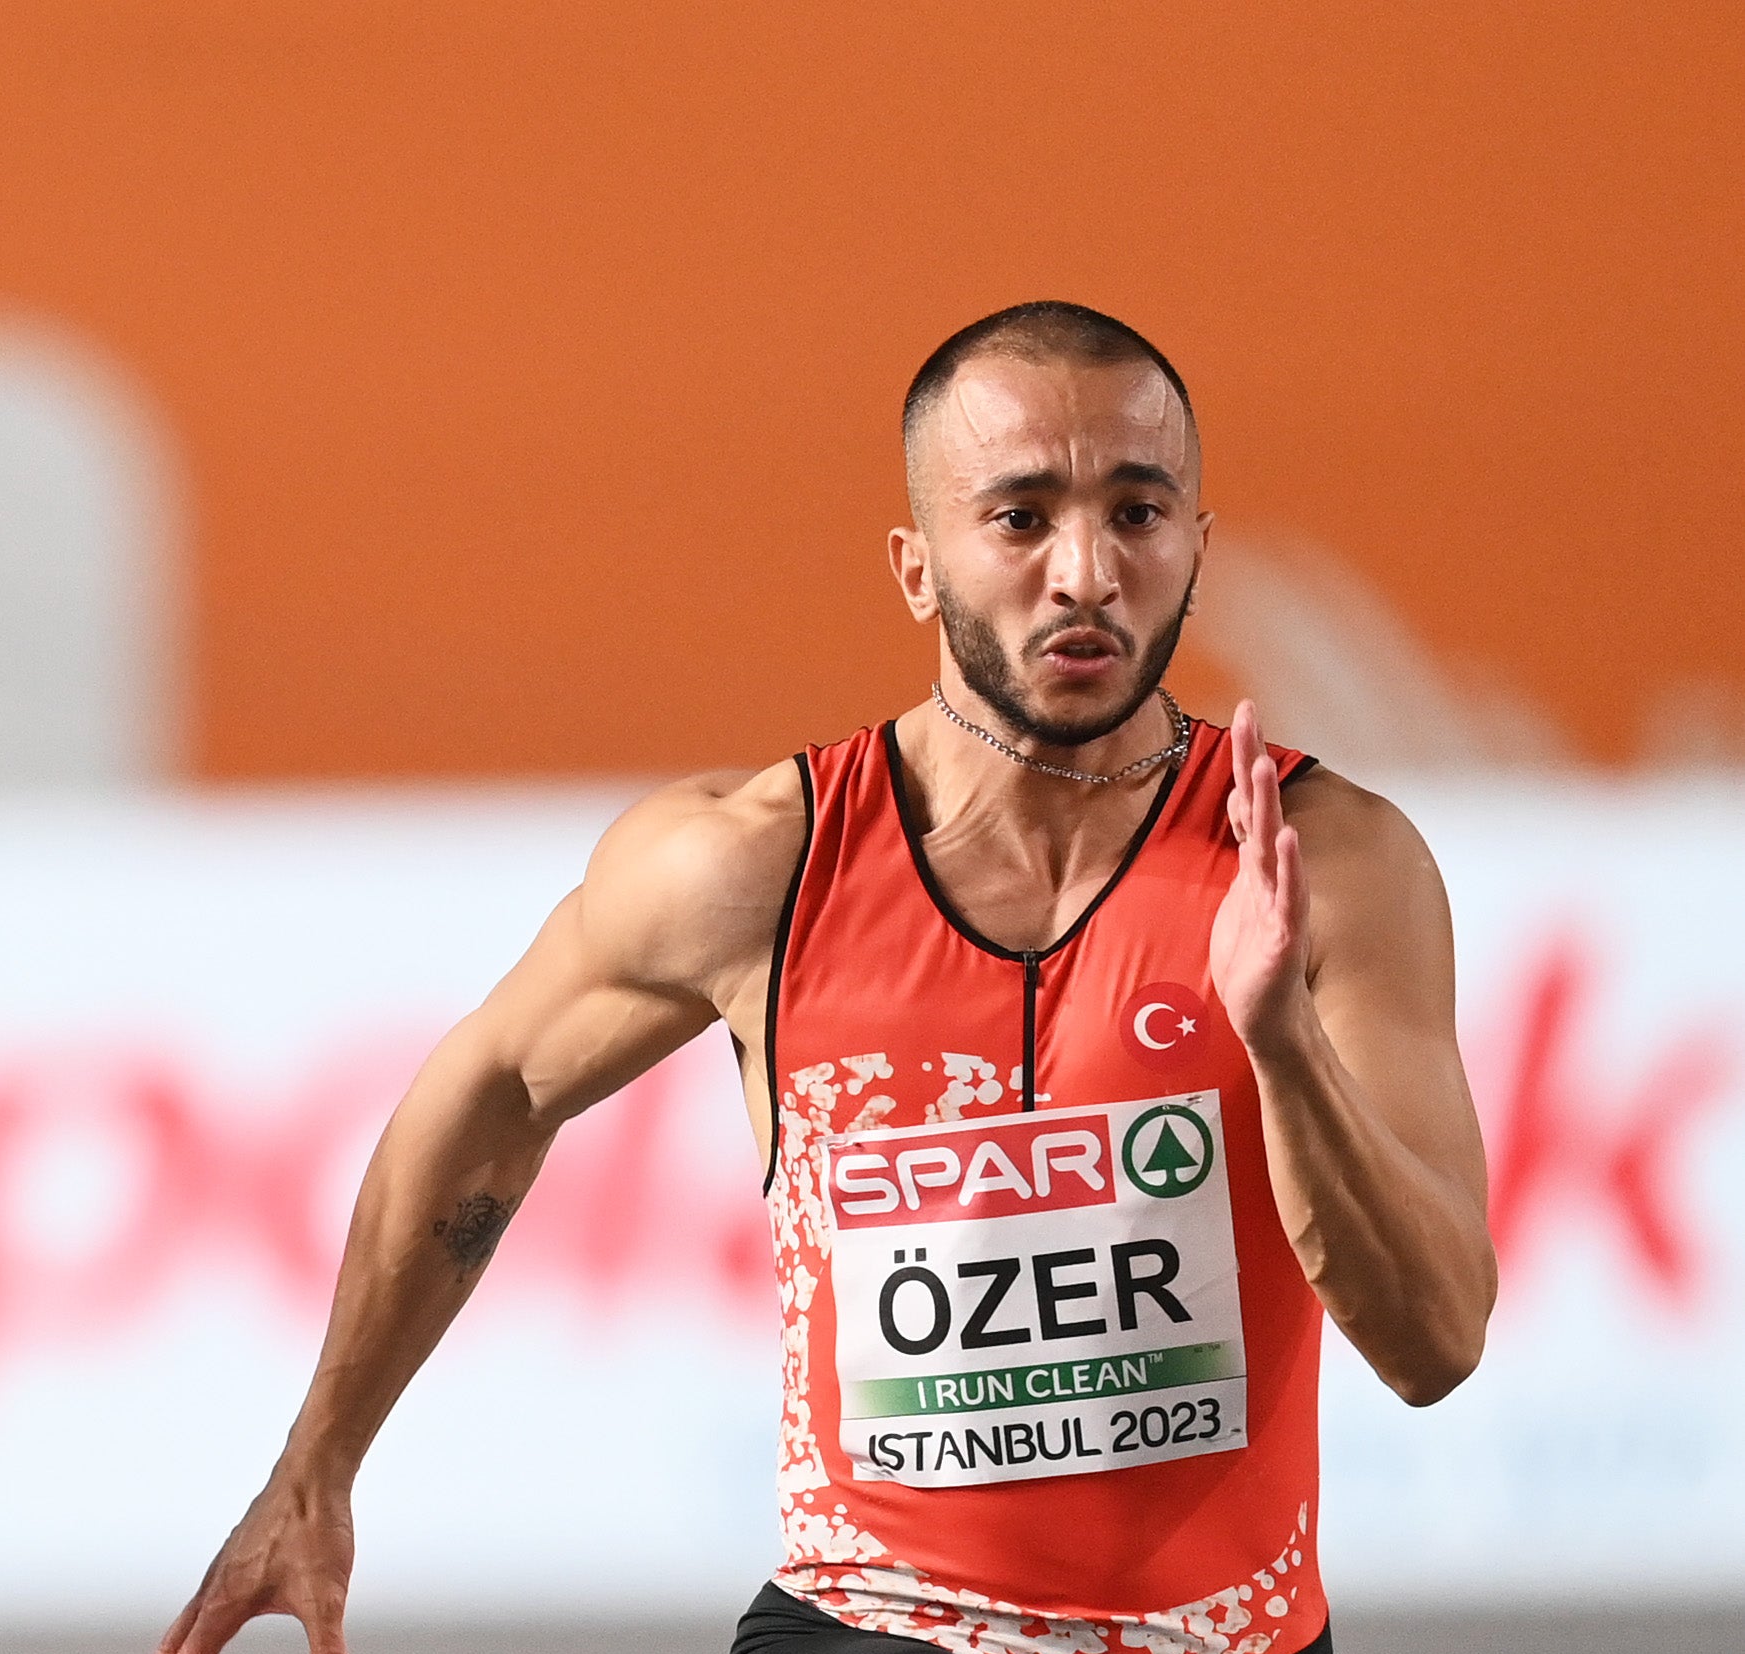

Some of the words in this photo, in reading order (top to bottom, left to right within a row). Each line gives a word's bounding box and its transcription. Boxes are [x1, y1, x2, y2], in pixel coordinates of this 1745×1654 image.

[834, 1129, 1105, 1216] SPAR
[878, 1238, 1193, 1356] ÖZER
[917, 1380, 928, 1410] I
[935, 1374, 1015, 1409] RUN
[868, 1416, 1103, 1472] ISTANBUL
[1110, 1398, 1222, 1453] 2023
